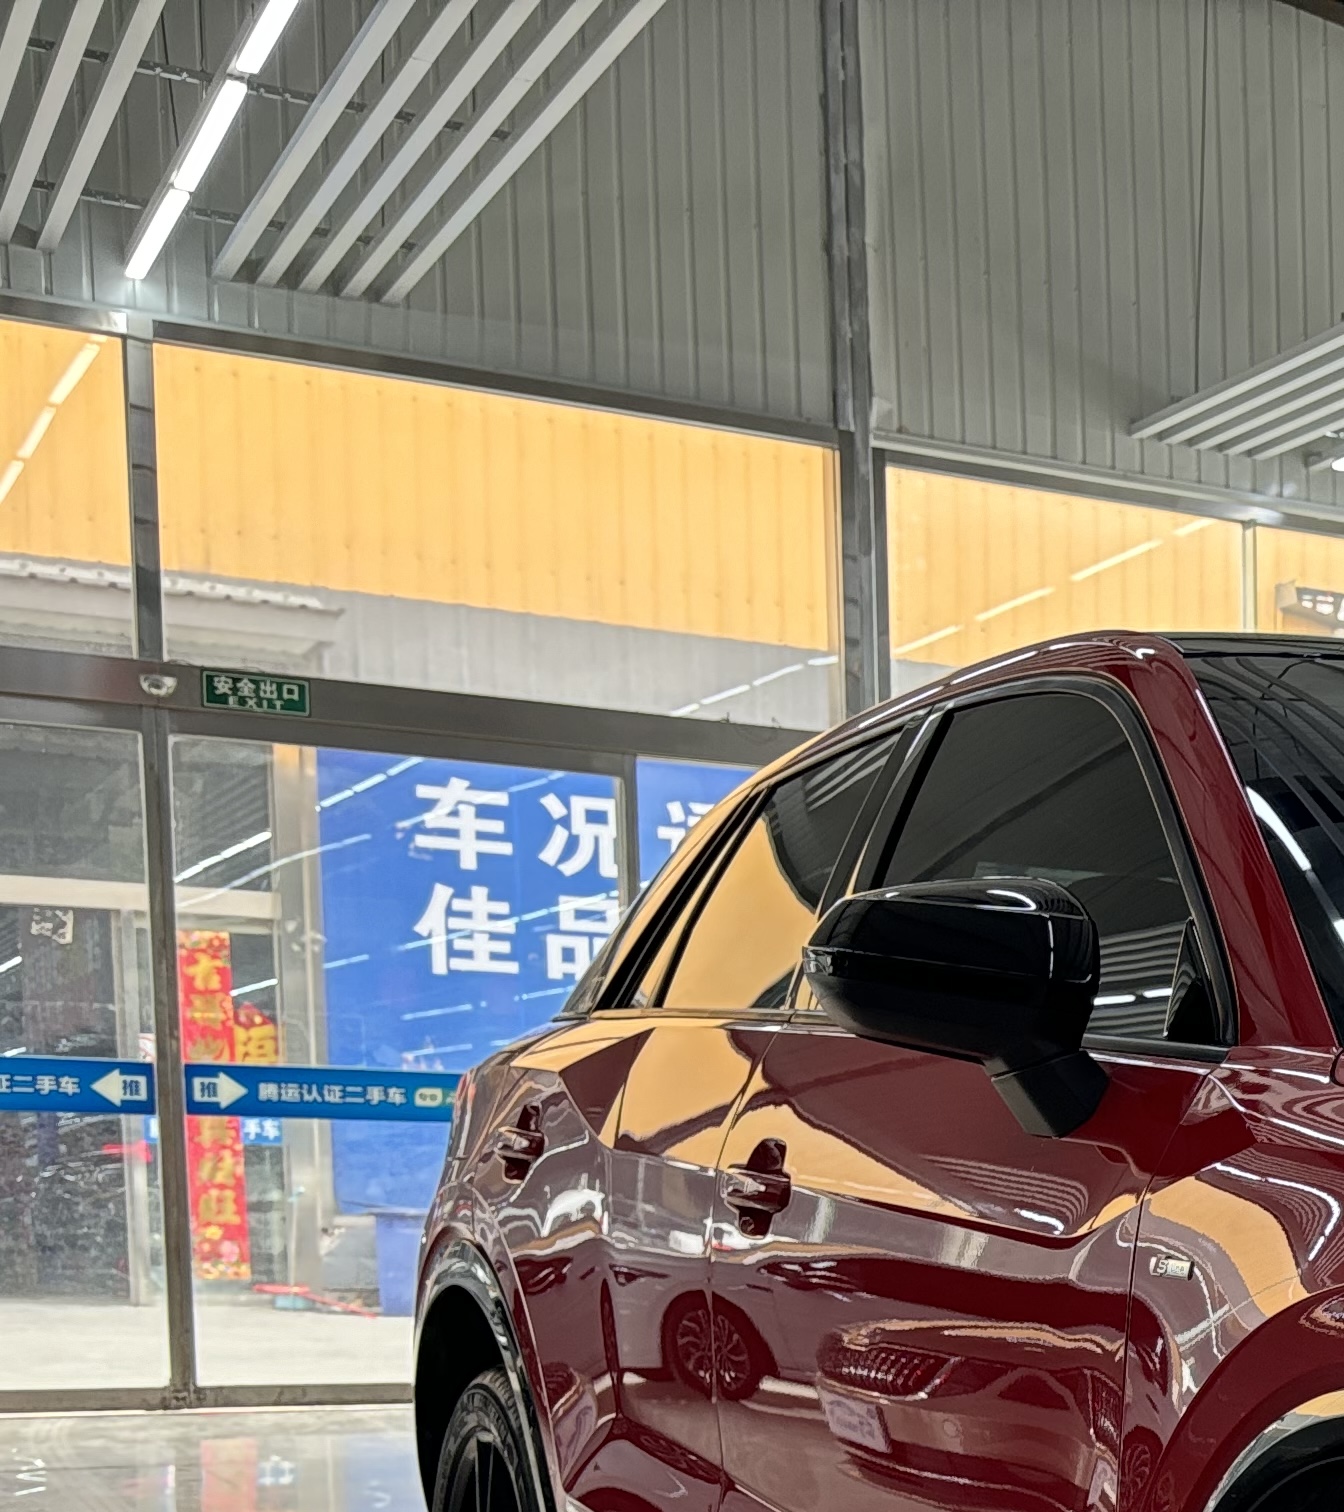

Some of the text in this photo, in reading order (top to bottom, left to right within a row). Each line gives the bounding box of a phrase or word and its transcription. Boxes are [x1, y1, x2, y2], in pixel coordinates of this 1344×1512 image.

[212, 675, 300, 701] 安全出口
[228, 696, 285, 712] EXIT
[412, 882, 621, 982] 佳品
[121, 1079, 142, 1097] 推
[199, 1081, 218, 1099] 推
[257, 1082, 408, 1106] 腾运认证二手车
